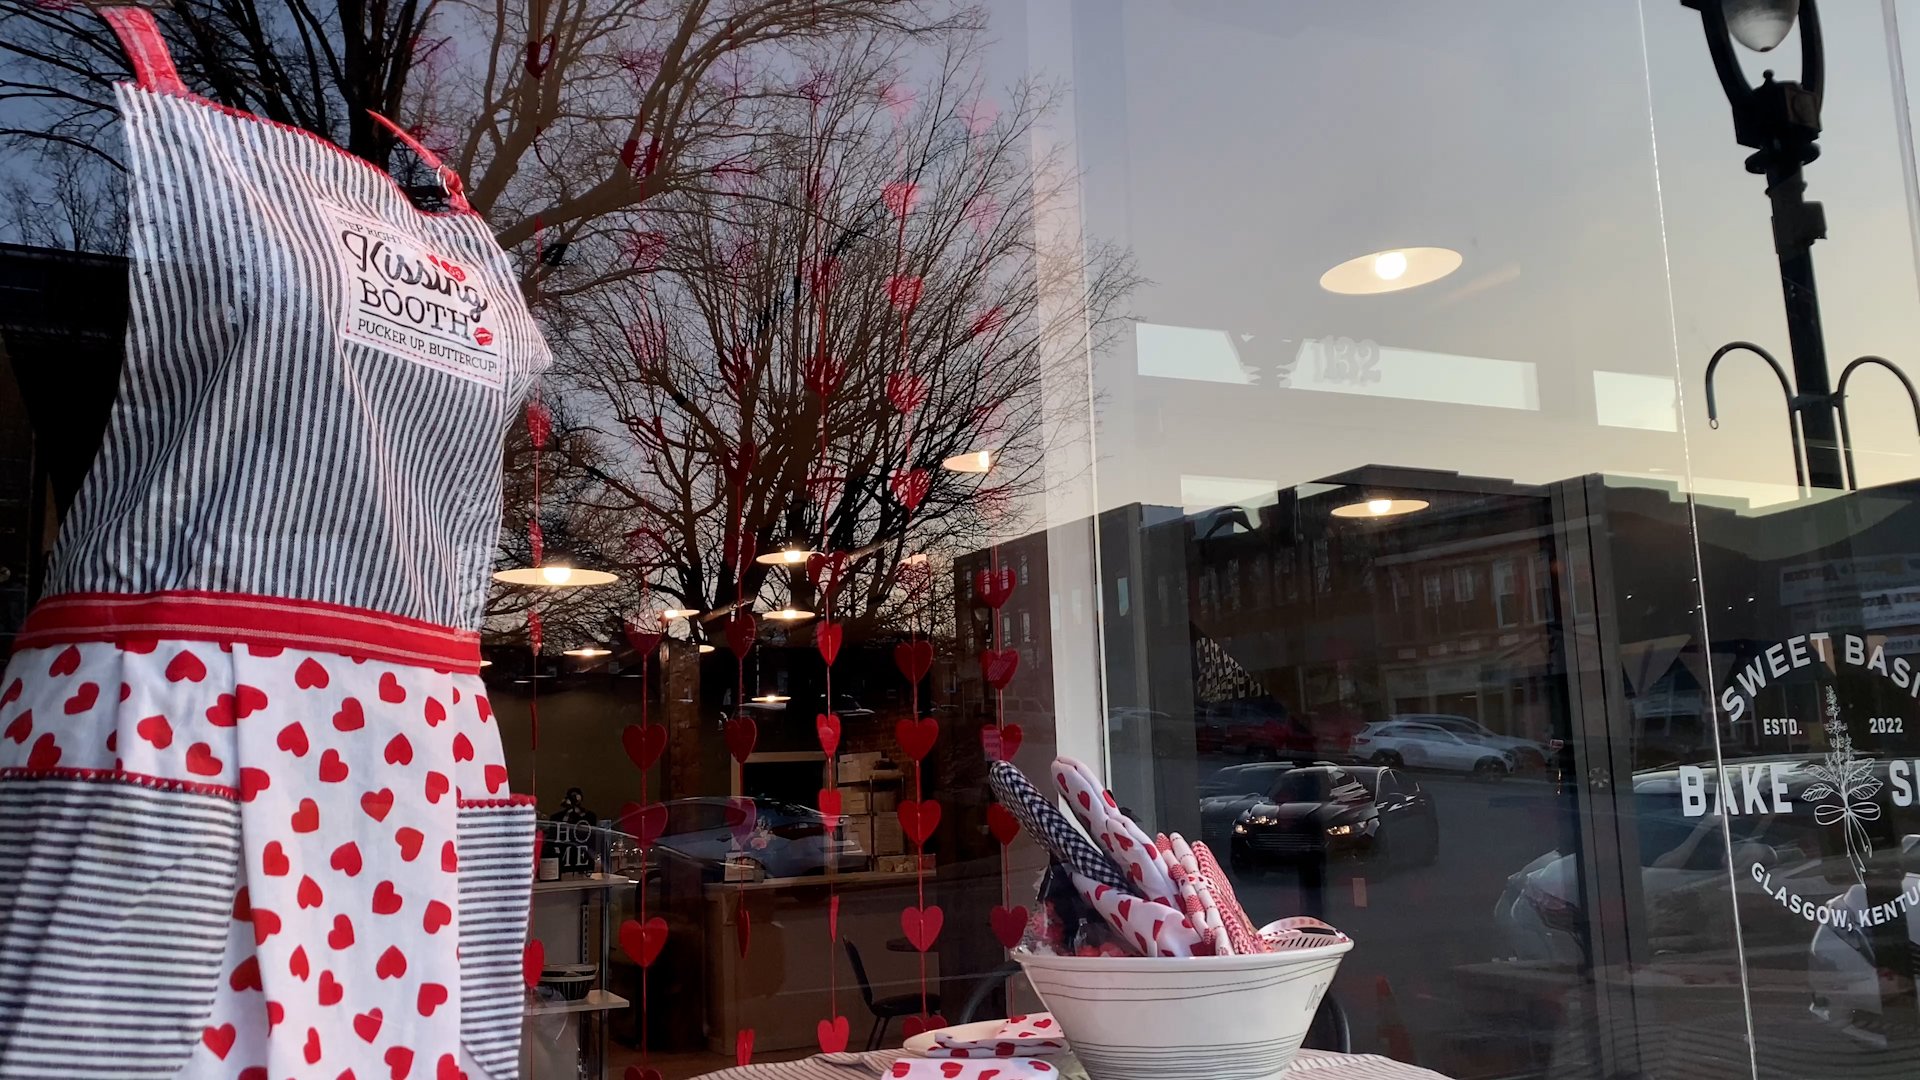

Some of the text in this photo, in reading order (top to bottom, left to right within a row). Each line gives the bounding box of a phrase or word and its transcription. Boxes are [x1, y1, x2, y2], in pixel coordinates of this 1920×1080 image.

[366, 227, 402, 245] RIGHT
[341, 230, 488, 323] Kissing
[357, 277, 471, 341] BOOTH
[358, 318, 407, 345] PUCKER
[409, 339, 426, 354] UP,
[1721, 632, 1829, 722] SWEET
[1763, 718, 1803, 735] ESTD.
[1869, 717, 1903, 734] 2022
[1679, 759, 1920, 817] BAKE S
[1751, 862, 1920, 931] GLASGOW, KENTU
